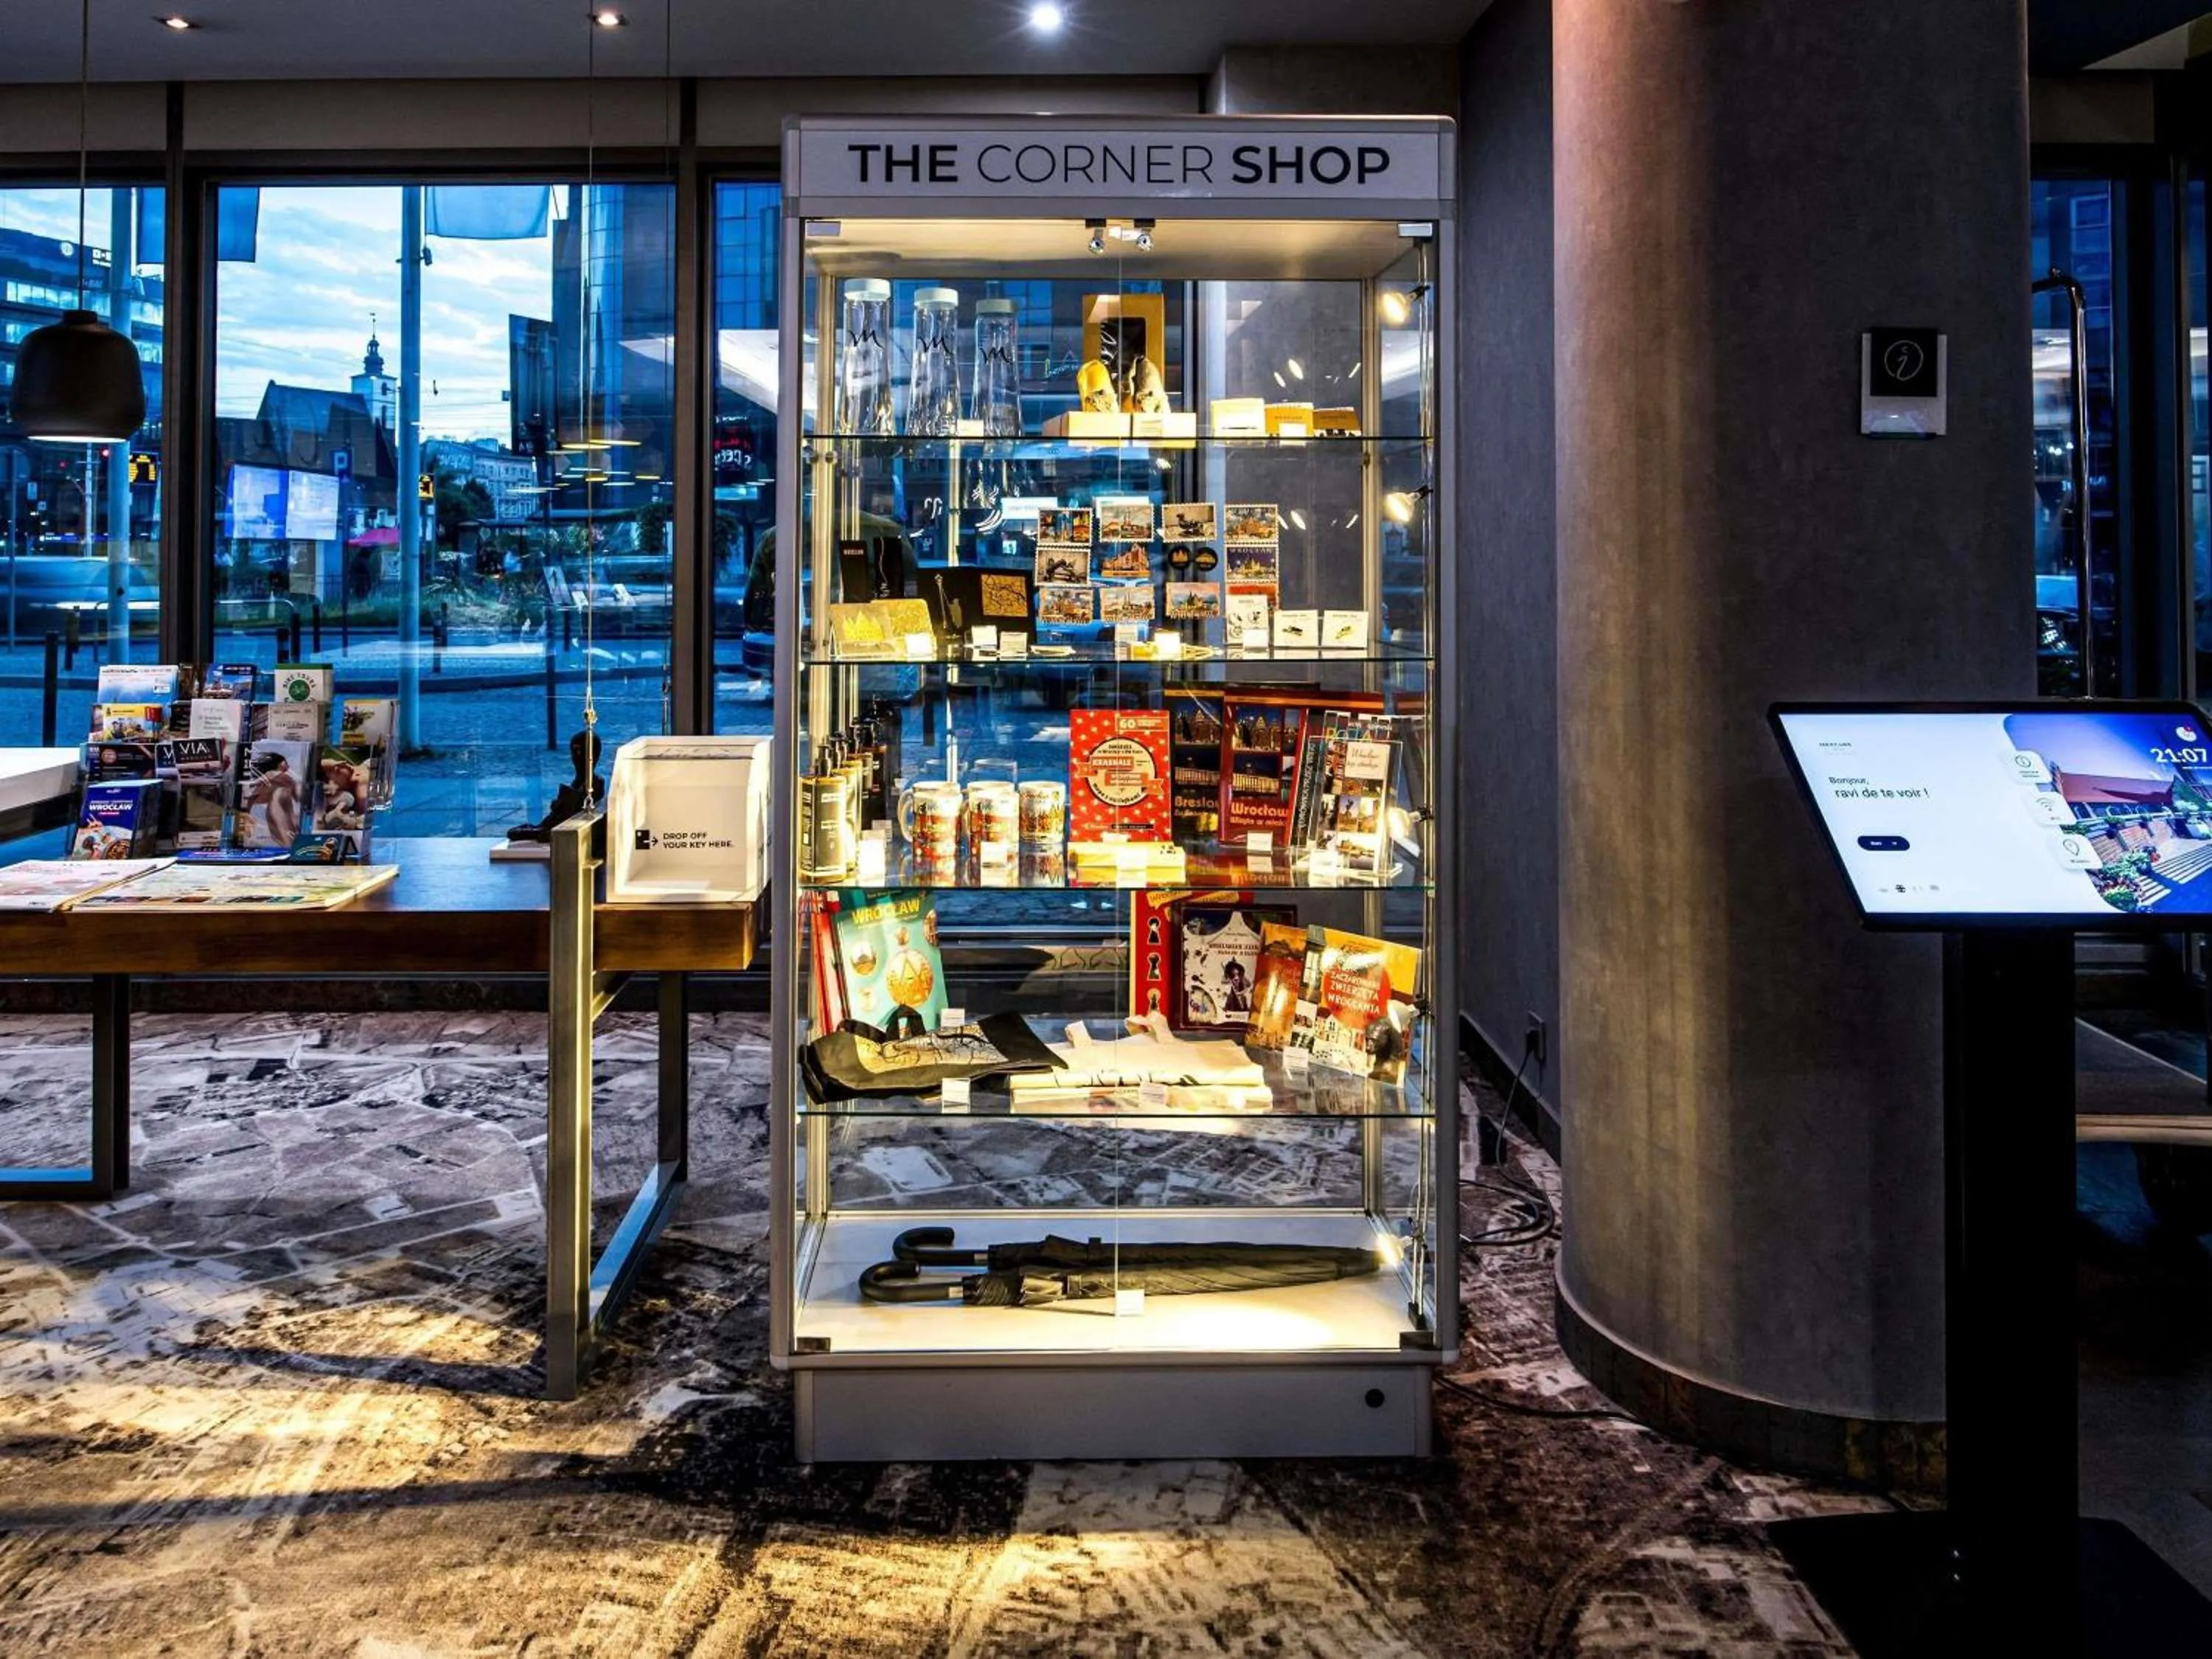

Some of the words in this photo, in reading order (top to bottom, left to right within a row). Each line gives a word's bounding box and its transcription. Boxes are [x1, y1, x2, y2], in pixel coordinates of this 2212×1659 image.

[848, 145, 958, 183] THE
[977, 144, 1214, 184] CORNER
[1231, 145, 1390, 184] SHOP
[333, 451, 349, 472] P
[1119, 718, 1136, 730] 60
[179, 742, 210, 756] VIA
[2149, 748, 2208, 764] 21:07
[1829, 776, 1870, 786] Bonjour,
[1834, 787, 1858, 799] ravi
[1862, 787, 1878, 799] de
[1880, 788, 1894, 799] te
[1896, 788, 1921, 799] voir
[709, 840, 734, 848] HERE.
[851, 897, 920, 925] WROCŁAW
